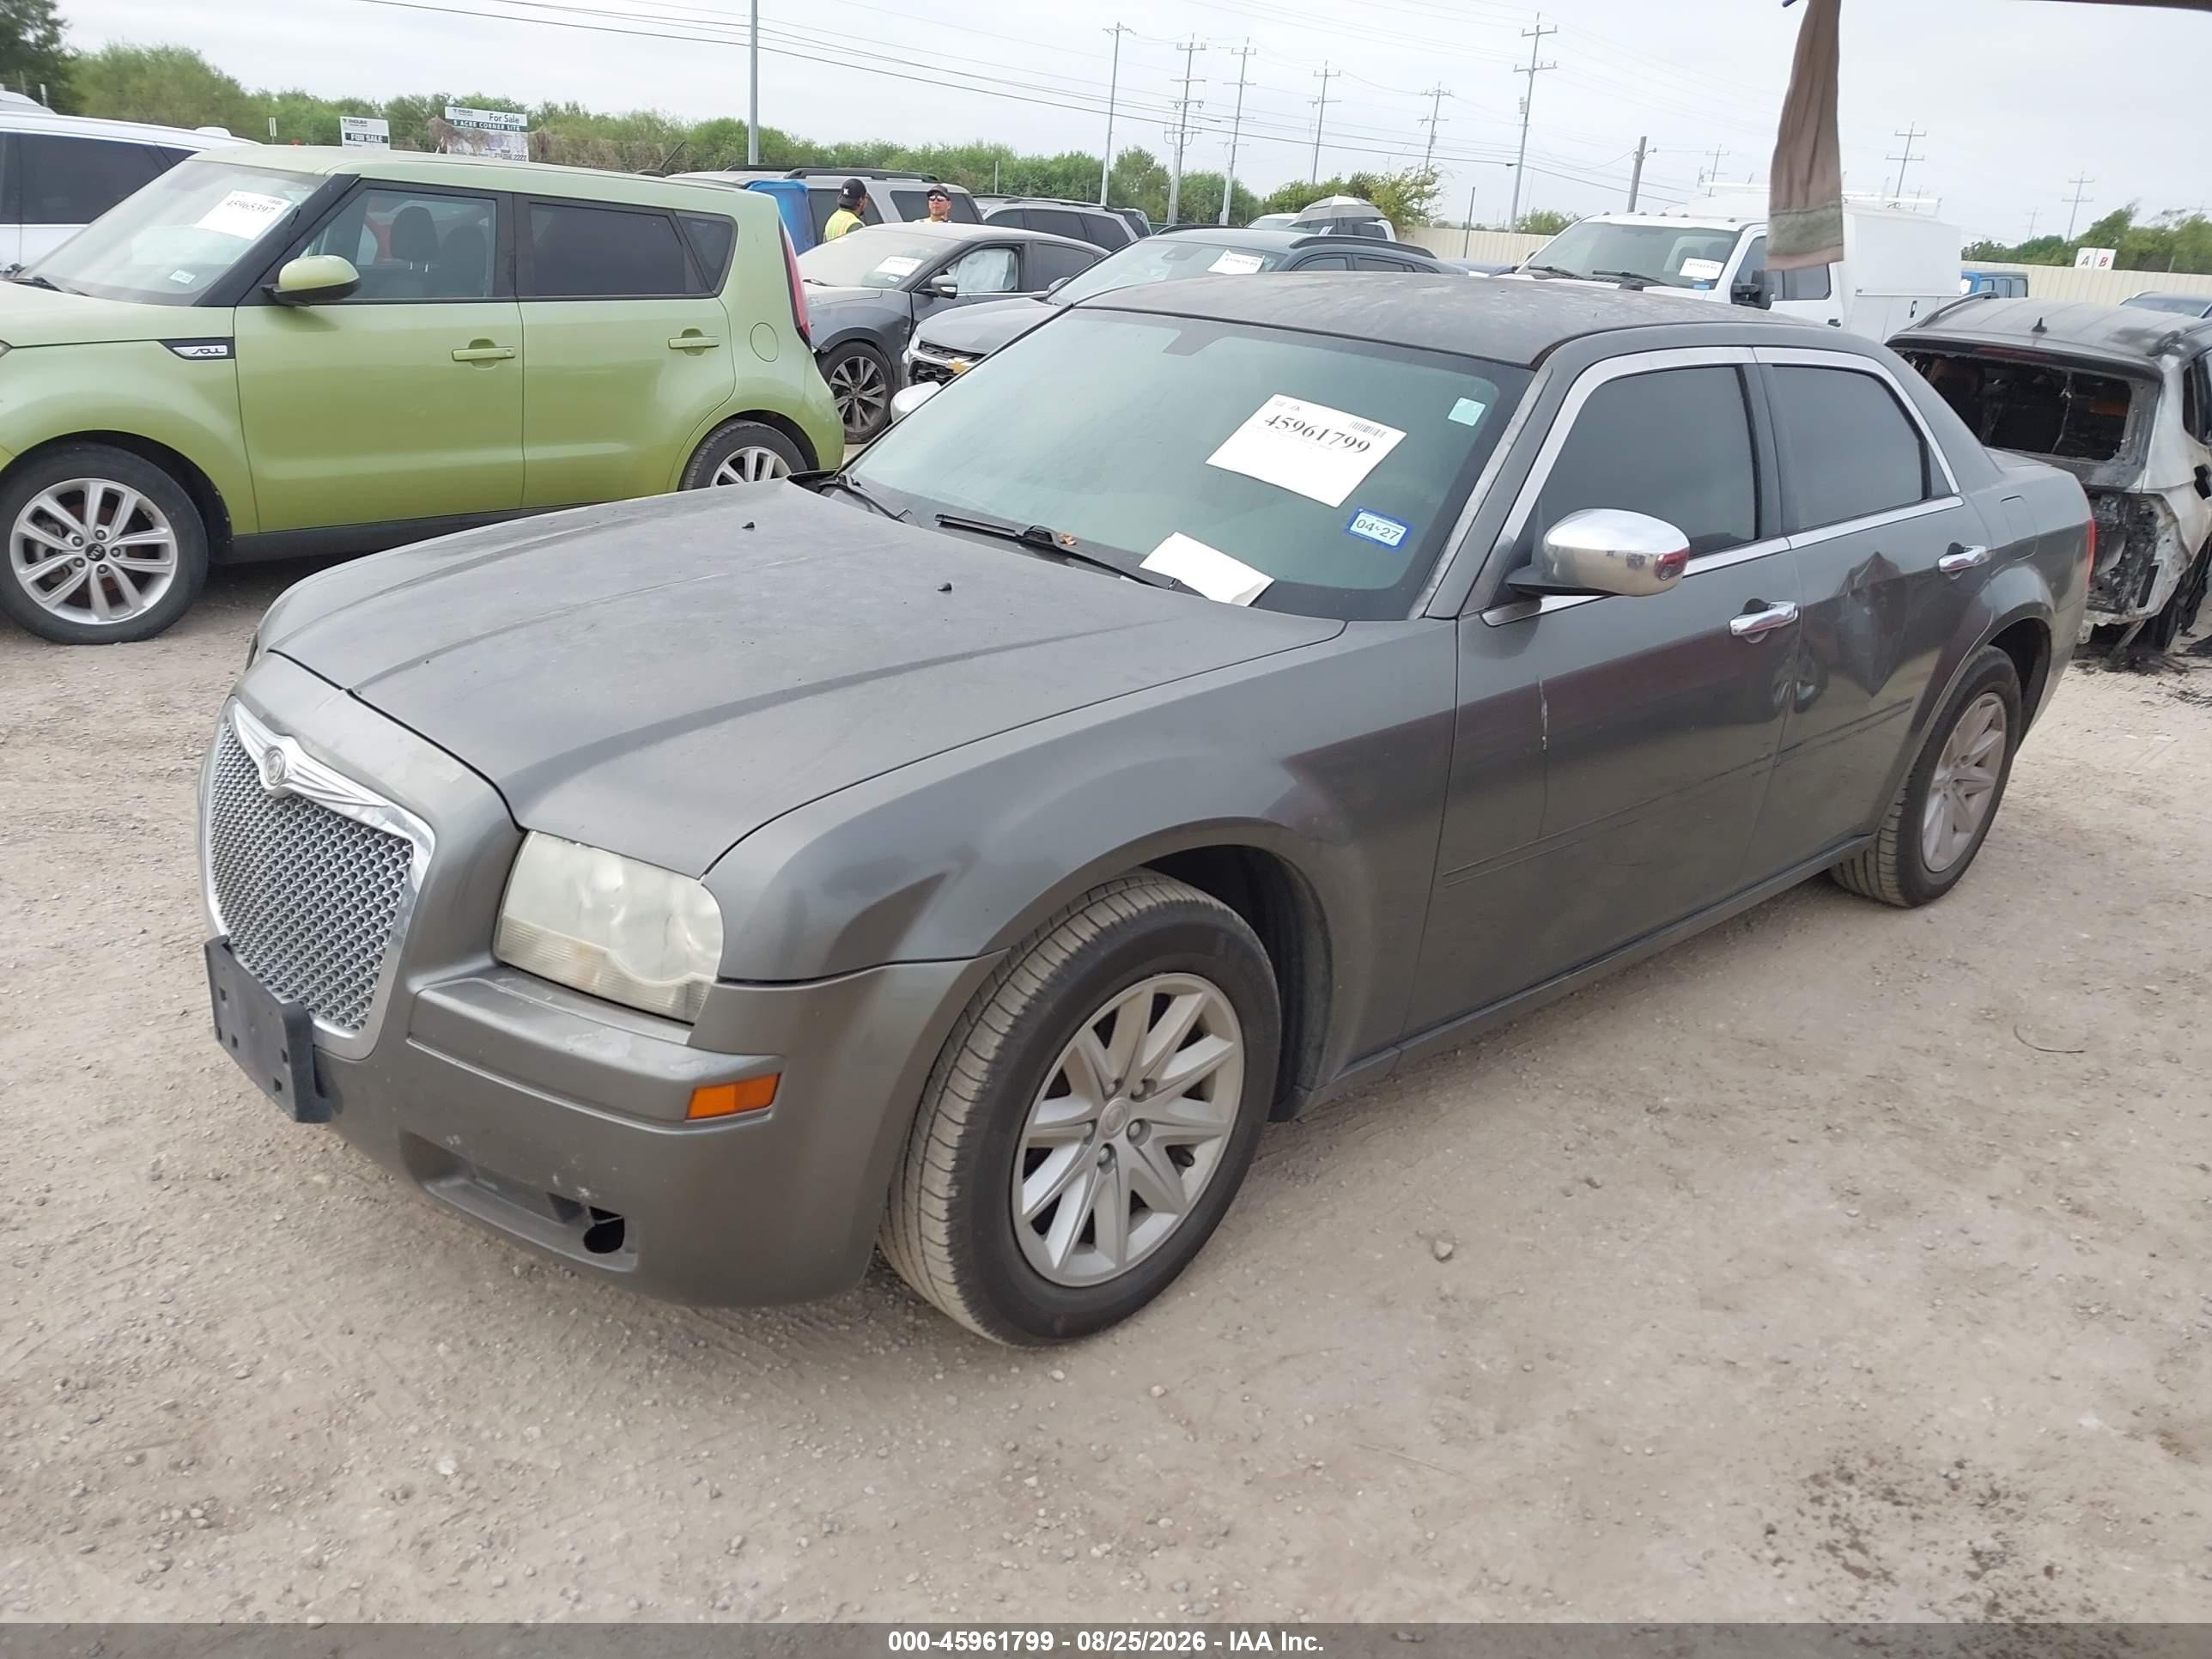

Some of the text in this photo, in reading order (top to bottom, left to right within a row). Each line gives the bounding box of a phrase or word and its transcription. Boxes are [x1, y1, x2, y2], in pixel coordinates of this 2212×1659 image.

[489, 112, 520, 124] For Sale
[365, 134, 383, 143] SALE
[2081, 255, 2090, 265] A
[2099, 257, 2109, 267] B
[1265, 414, 1370, 453] 45961799
